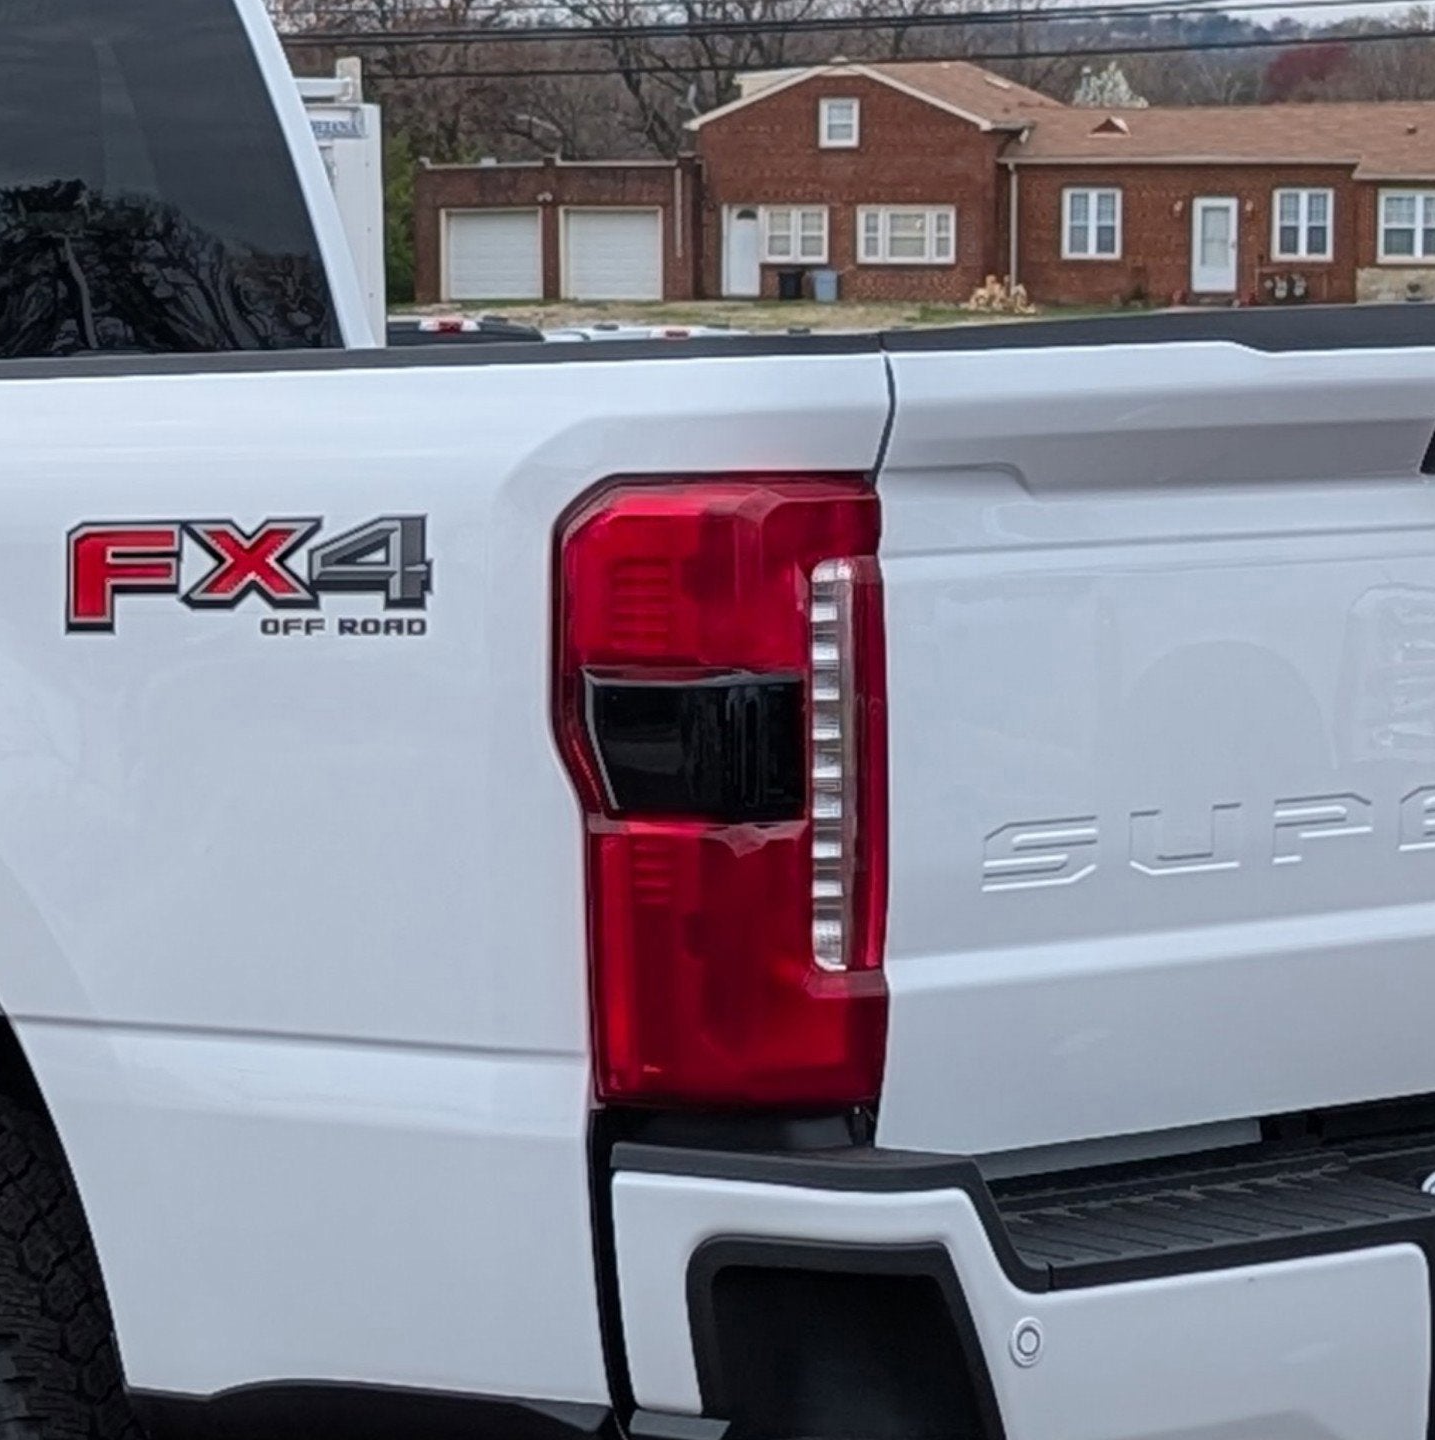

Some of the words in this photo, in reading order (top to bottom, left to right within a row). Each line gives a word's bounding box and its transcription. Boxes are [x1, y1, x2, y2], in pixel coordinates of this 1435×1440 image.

[65, 513, 433, 636] FX4
[260, 617, 326, 637] OFF
[337, 617, 427, 637] ROAD
